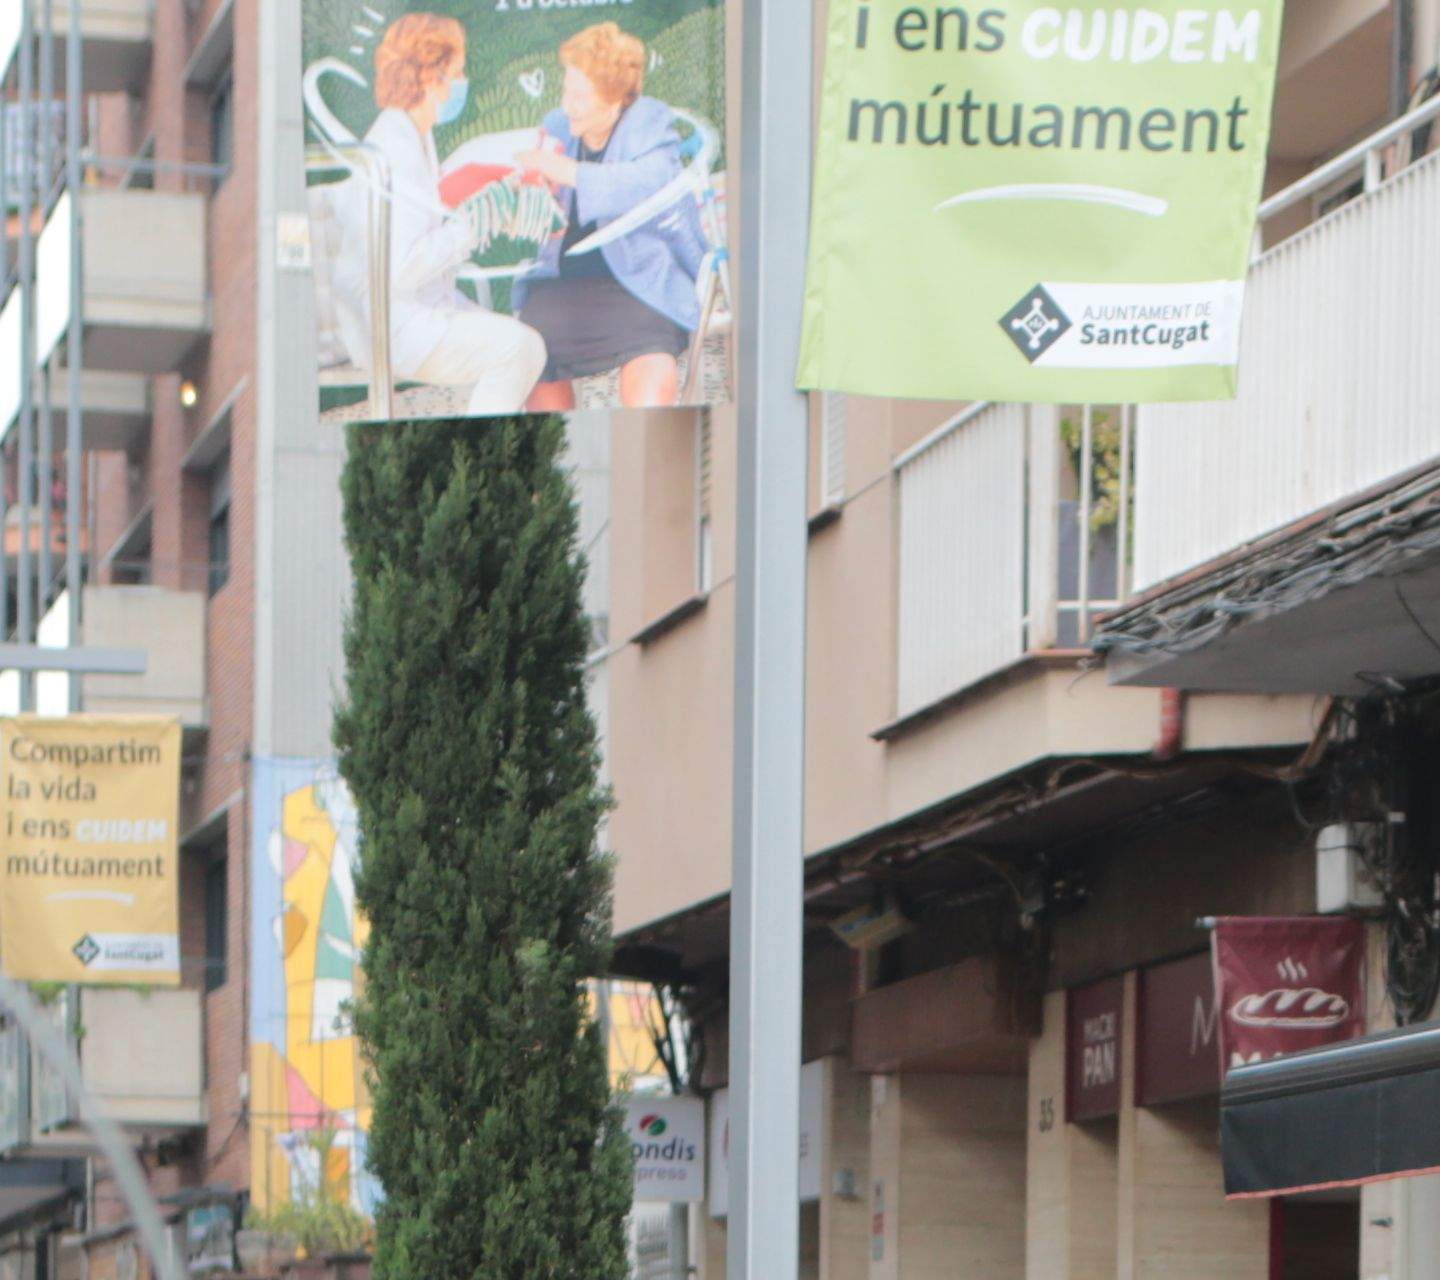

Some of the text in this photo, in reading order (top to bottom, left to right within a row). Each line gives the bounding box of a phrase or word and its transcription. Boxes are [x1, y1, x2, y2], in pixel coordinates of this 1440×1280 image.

[894, 4, 1006, 52] ens
[1021, 7, 1262, 64] CUIDEM
[846, 84, 1250, 154] mútuament
[1082, 301, 1213, 321] AJUNTAMENT DE
[1079, 320, 1211, 350] SantCugat
[9, 737, 162, 768] Compartim
[7, 774, 98, 802] la vida
[6, 811, 168, 844] i ens CUIDEM
[6, 850, 165, 878] mútuament
[1083, 1040, 1116, 1088] PAN
[630, 1134, 697, 1161] ondis
[637, 1165, 689, 1183] press
